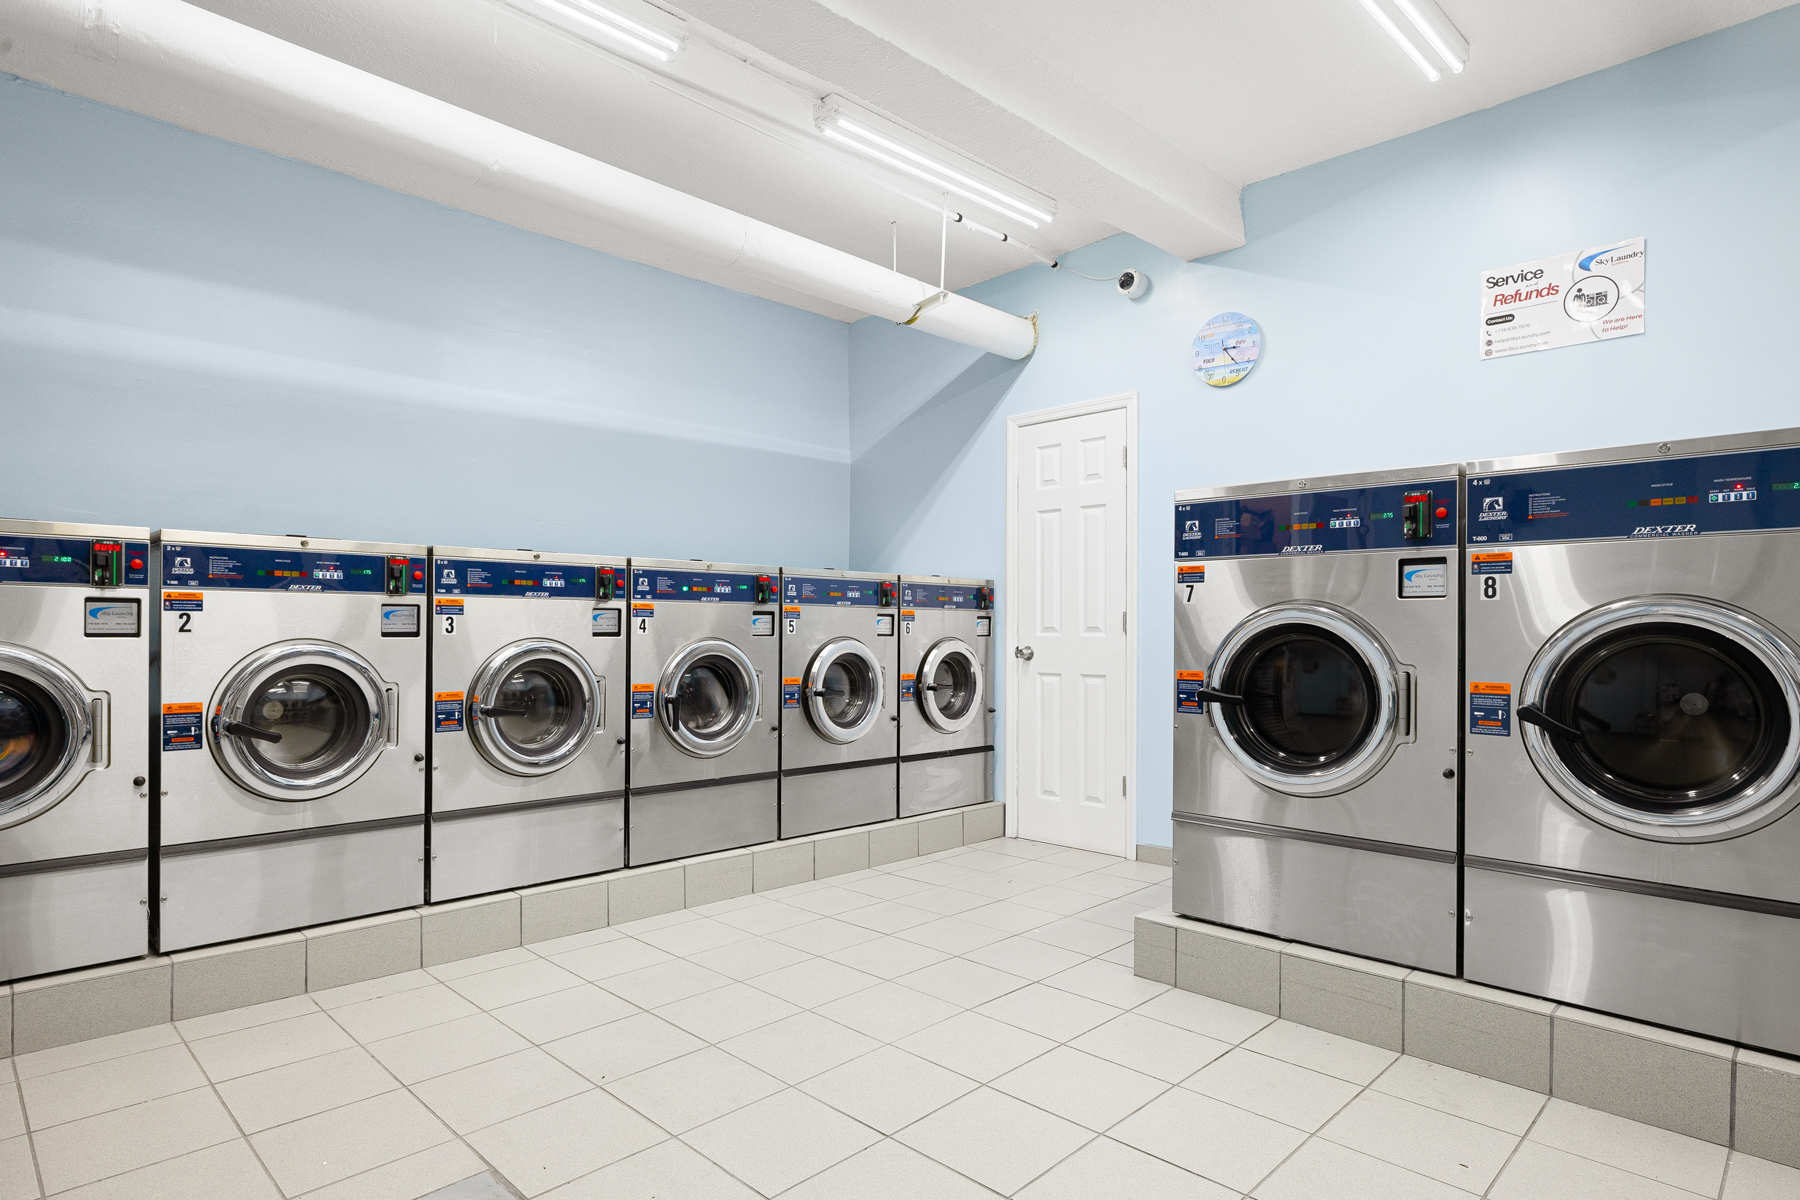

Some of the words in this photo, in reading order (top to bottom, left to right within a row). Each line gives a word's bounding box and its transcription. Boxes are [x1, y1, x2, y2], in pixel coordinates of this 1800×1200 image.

[1595, 258, 1610, 266] Sky
[1610, 250, 1644, 262] Laundry
[1486, 268, 1544, 289] Service
[1492, 282, 1560, 307] Refunds
[1632, 524, 1697, 535] DEXTER
[1282, 544, 1323, 552] DEXTER
[1186, 585, 1194, 603] 7
[1484, 576, 1497, 598] 8
[178, 612, 191, 632] 2
[445, 616, 454, 634] 3
[639, 618, 646, 633] 4
[788, 620, 794, 633] 5
[906, 622, 910, 634] 6
